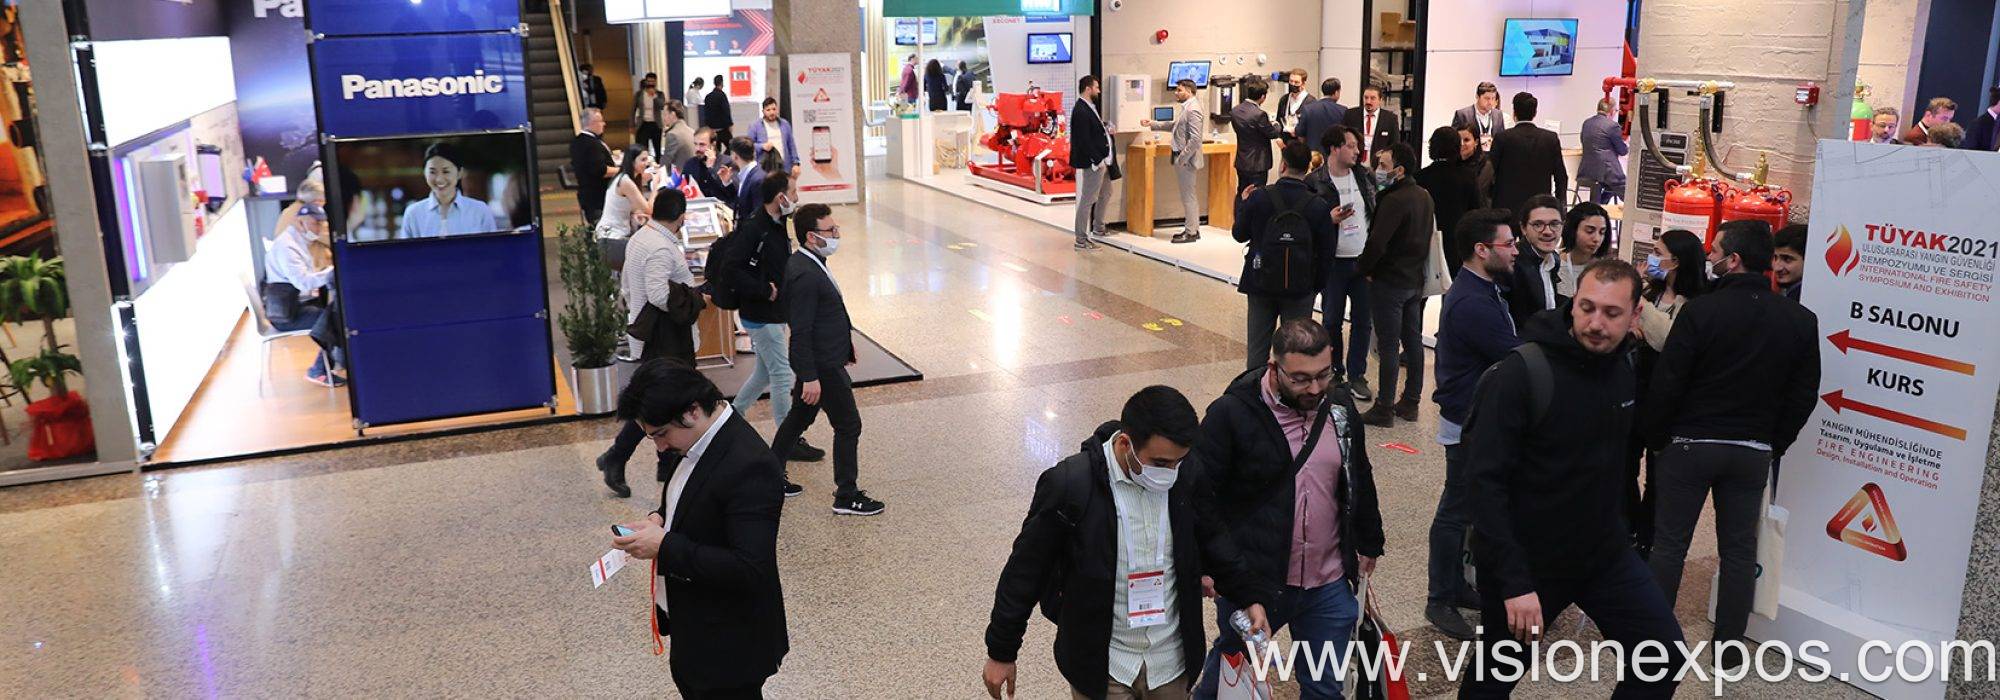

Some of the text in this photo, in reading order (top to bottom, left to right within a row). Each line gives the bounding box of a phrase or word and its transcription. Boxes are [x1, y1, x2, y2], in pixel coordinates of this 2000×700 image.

[341, 69, 504, 100] Panasonic
[1862, 243, 1918, 260] ULUSLARARASI
[1860, 254, 1994, 283] SEMPOZYUMU VE SERGİSİ
[1860, 264, 1993, 292] INTERNATIONAL FIRE SAFETY
[1858, 274, 1990, 303] SYMPOSIUM AND EXHIBITION
[1850, 301, 1960, 338] B SALONU
[1867, 368, 1925, 396] KURS
[1821, 418, 1853, 435] YANGIN
[1817, 439, 1940, 481] FIRE ENGINEERING
[1854, 439, 1894, 457] Uygulama
[1896, 451, 1906, 460] ve
[1843, 456, 1883, 474] Installation
[1884, 468, 1898, 478] and
[1900, 472, 1938, 490] Operation
